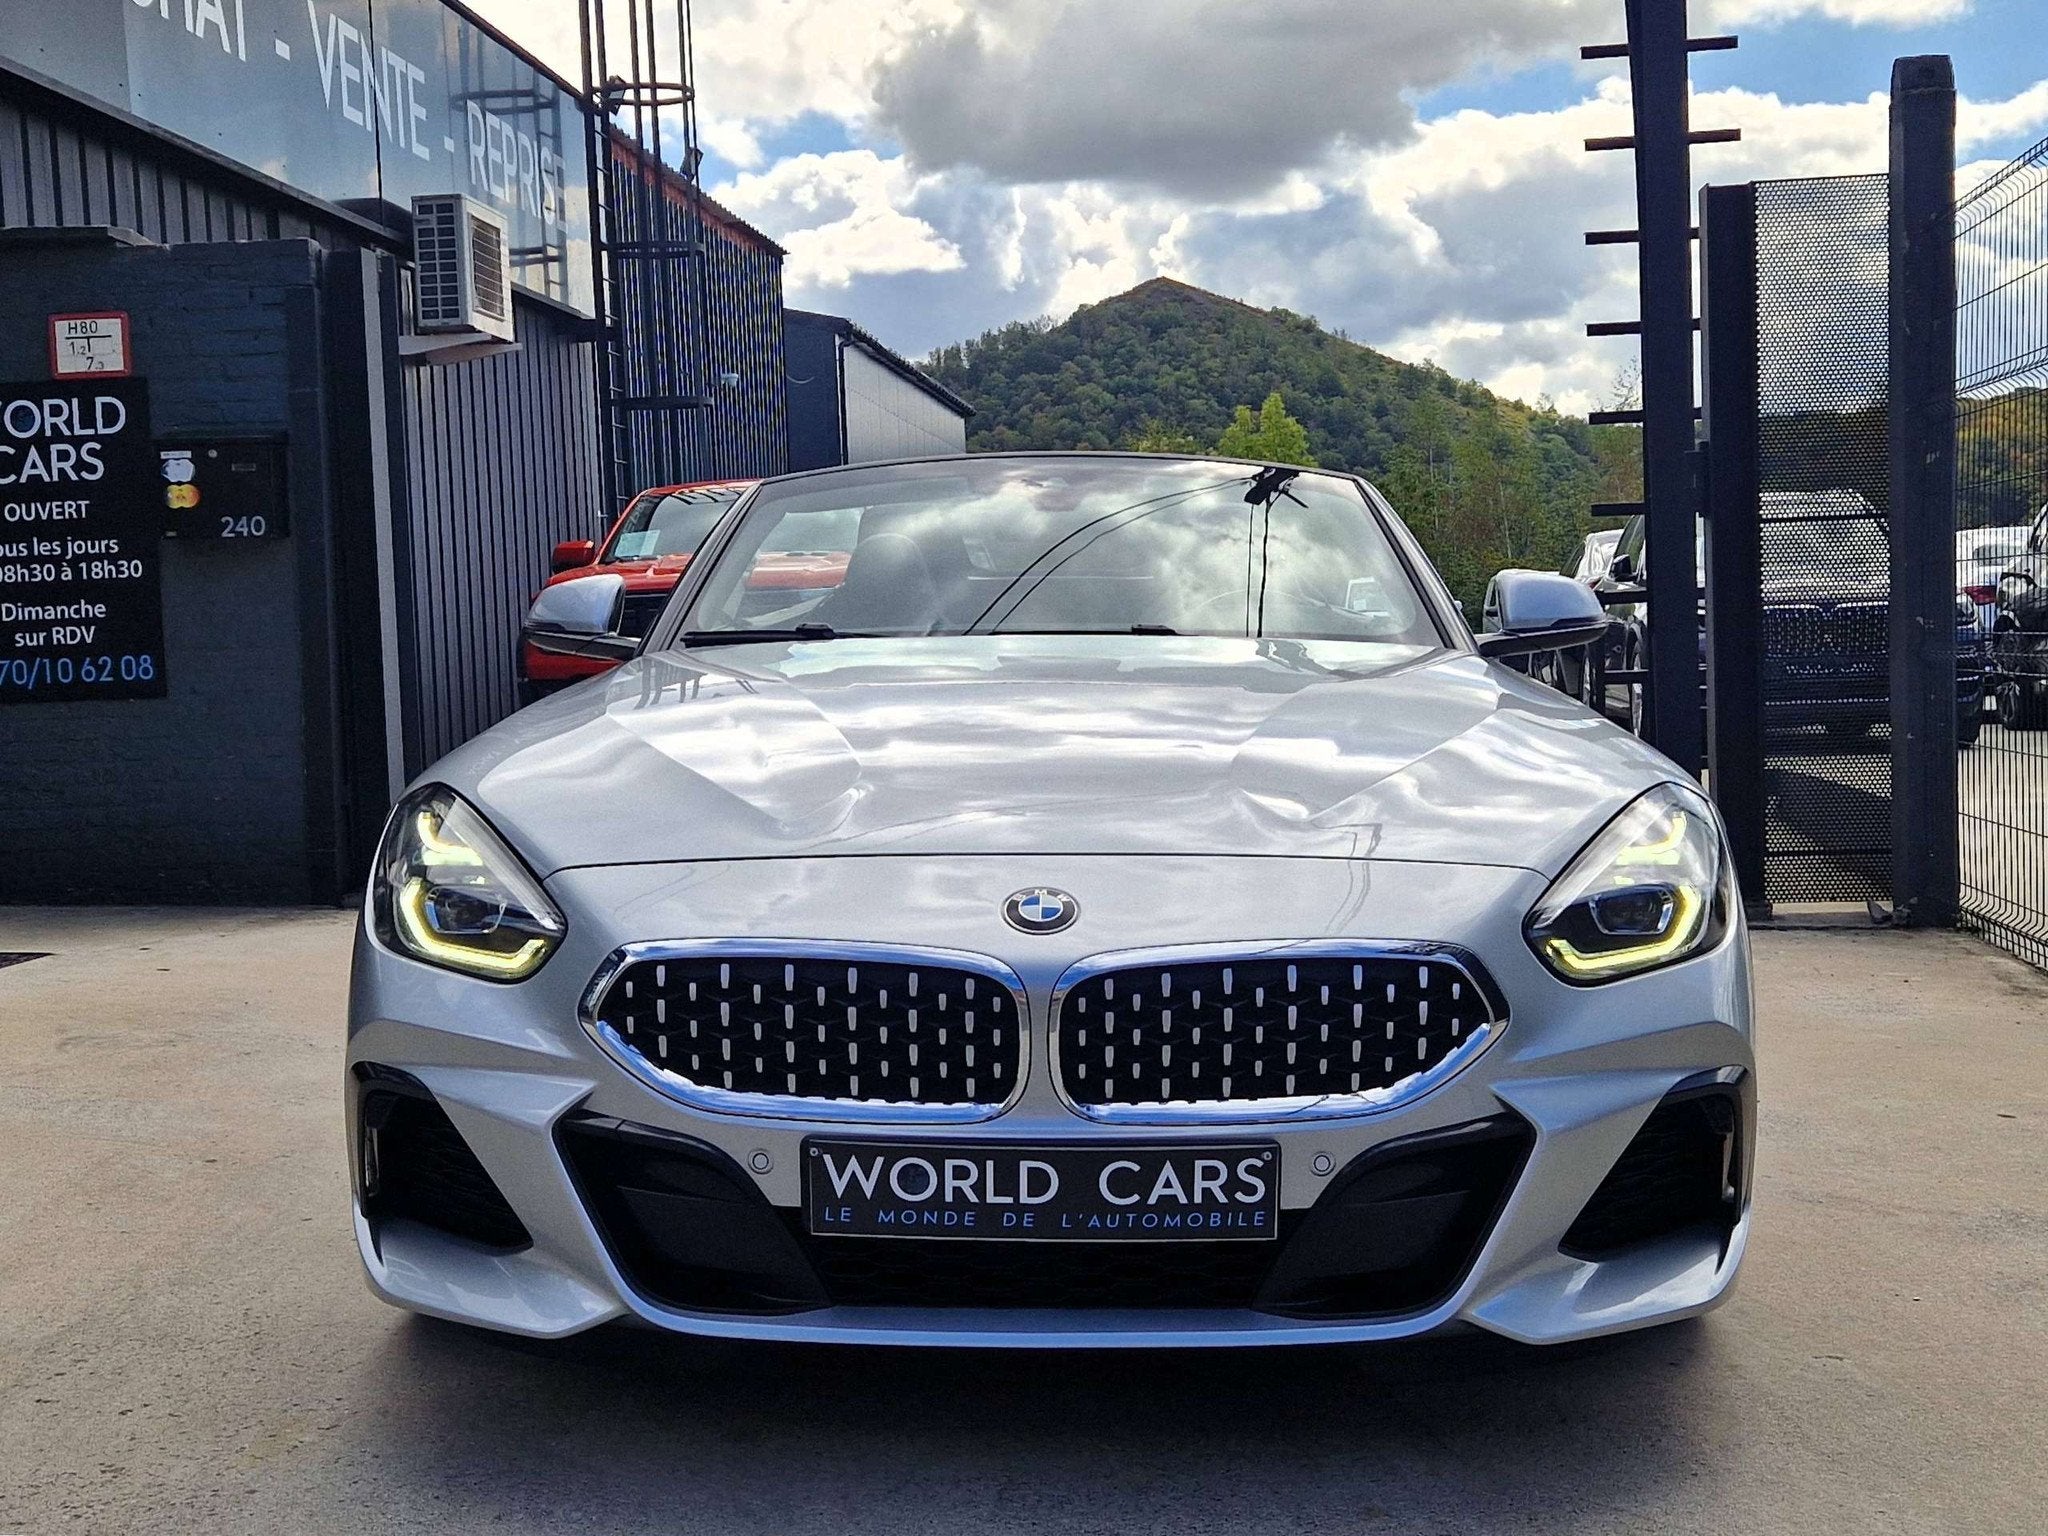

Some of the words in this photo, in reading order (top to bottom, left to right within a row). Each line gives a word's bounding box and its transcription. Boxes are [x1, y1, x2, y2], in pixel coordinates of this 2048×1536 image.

[307, 0, 430, 161] VENTE
[466, 99, 569, 234] REPRISE
[68, 321, 98, 334] H80
[0, 396, 126, 438] ORLD
[4, 501, 90, 522] OUVERT
[221, 516, 266, 537] 240
[0, 542, 28, 557] us
[33, 537, 61, 556] les
[65, 537, 119, 559] jours
[0, 563, 55, 582] 8h30
[60, 562, 73, 581] à
[79, 559, 143, 580] 18h30
[1, 599, 107, 621] Dimanche
[15, 632, 47, 647] sur
[52, 626, 96, 645] RDV
[81, 656, 114, 682] 62
[121, 655, 154, 681] 08
[822, 1154, 1060, 1205] WORLD
[1098, 1157, 1267, 1206] CARS
[824, 1207, 853, 1223] LE
[878, 1208, 977, 1227] MONDE
[1003, 1212, 1036, 1228] DE
[1062, 1210, 1267, 1229] L'AUTOMOBILE
